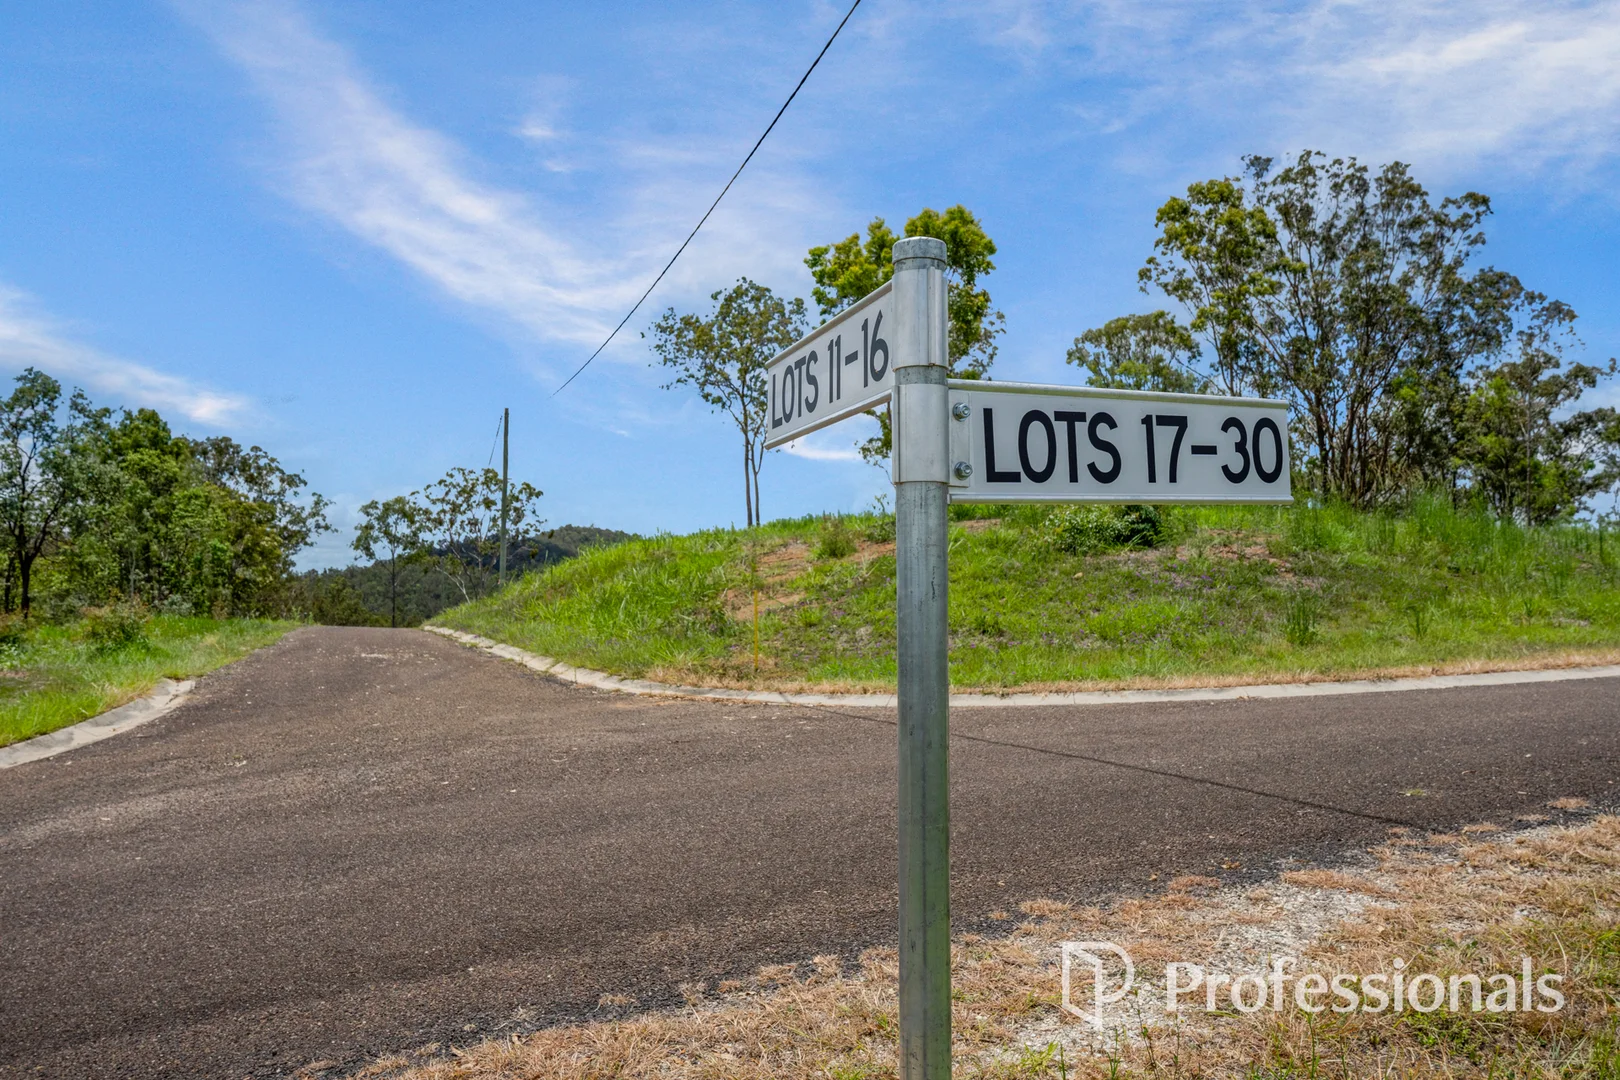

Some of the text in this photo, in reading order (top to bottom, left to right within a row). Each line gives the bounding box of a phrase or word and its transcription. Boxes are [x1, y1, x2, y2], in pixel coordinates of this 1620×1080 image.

[771, 309, 889, 429] LOTS 11-16
[983, 407, 1284, 484] LOTS 17-30
